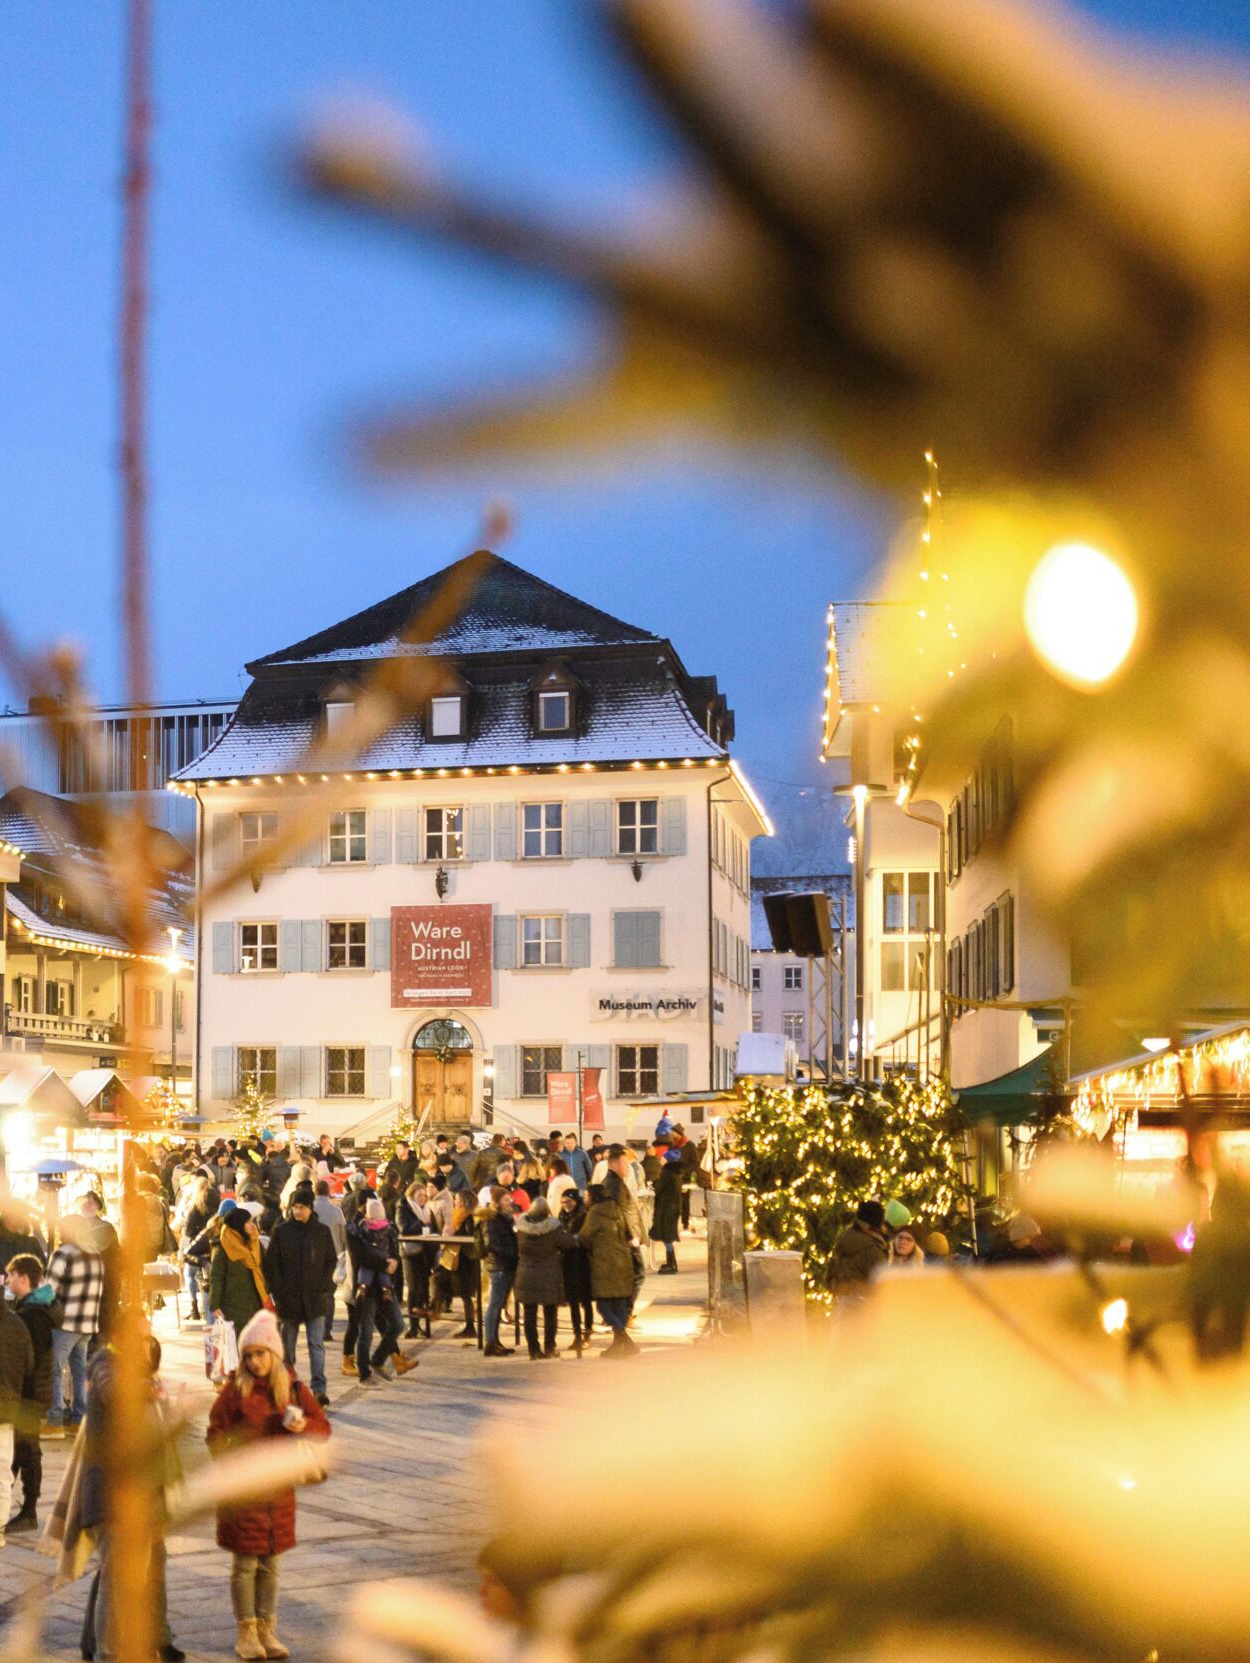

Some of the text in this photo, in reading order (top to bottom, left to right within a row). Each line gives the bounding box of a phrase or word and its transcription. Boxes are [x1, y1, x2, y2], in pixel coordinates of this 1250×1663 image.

[410, 921, 463, 938] Ware
[411, 941, 471, 961] Dirndl
[599, 998, 698, 1010] Museum Archiv
